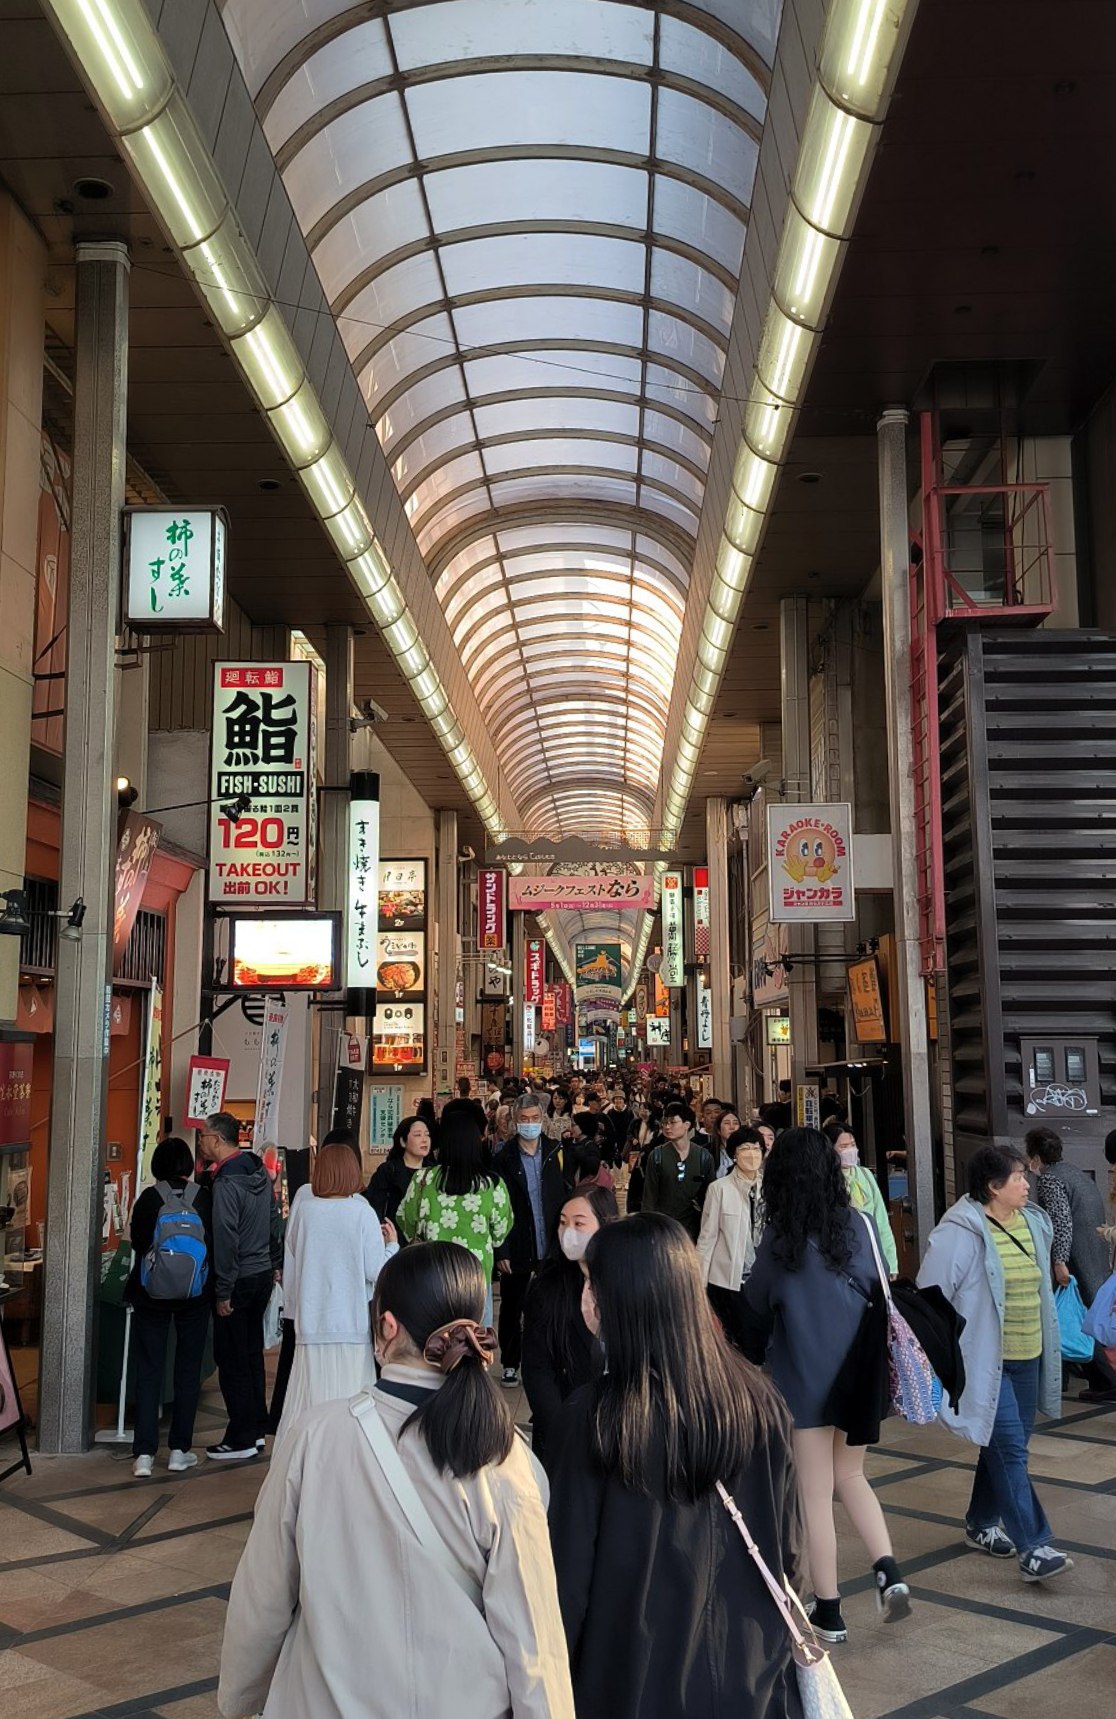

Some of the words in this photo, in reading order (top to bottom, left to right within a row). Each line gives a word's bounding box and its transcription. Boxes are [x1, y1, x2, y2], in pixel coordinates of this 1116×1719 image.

[166, 519, 194, 597] 柿の葉
[148, 557, 165, 613] すし
[224, 670, 280, 685] 廻転鮨
[222, 690, 298, 767] 鮨
[215, 863, 301, 877] TAKEOUT
[485, 872, 497, 934] サンドラッグ
[521, 880, 640, 898] ムジークフェストなら
[783, 887, 842, 900] ジャンカラ
